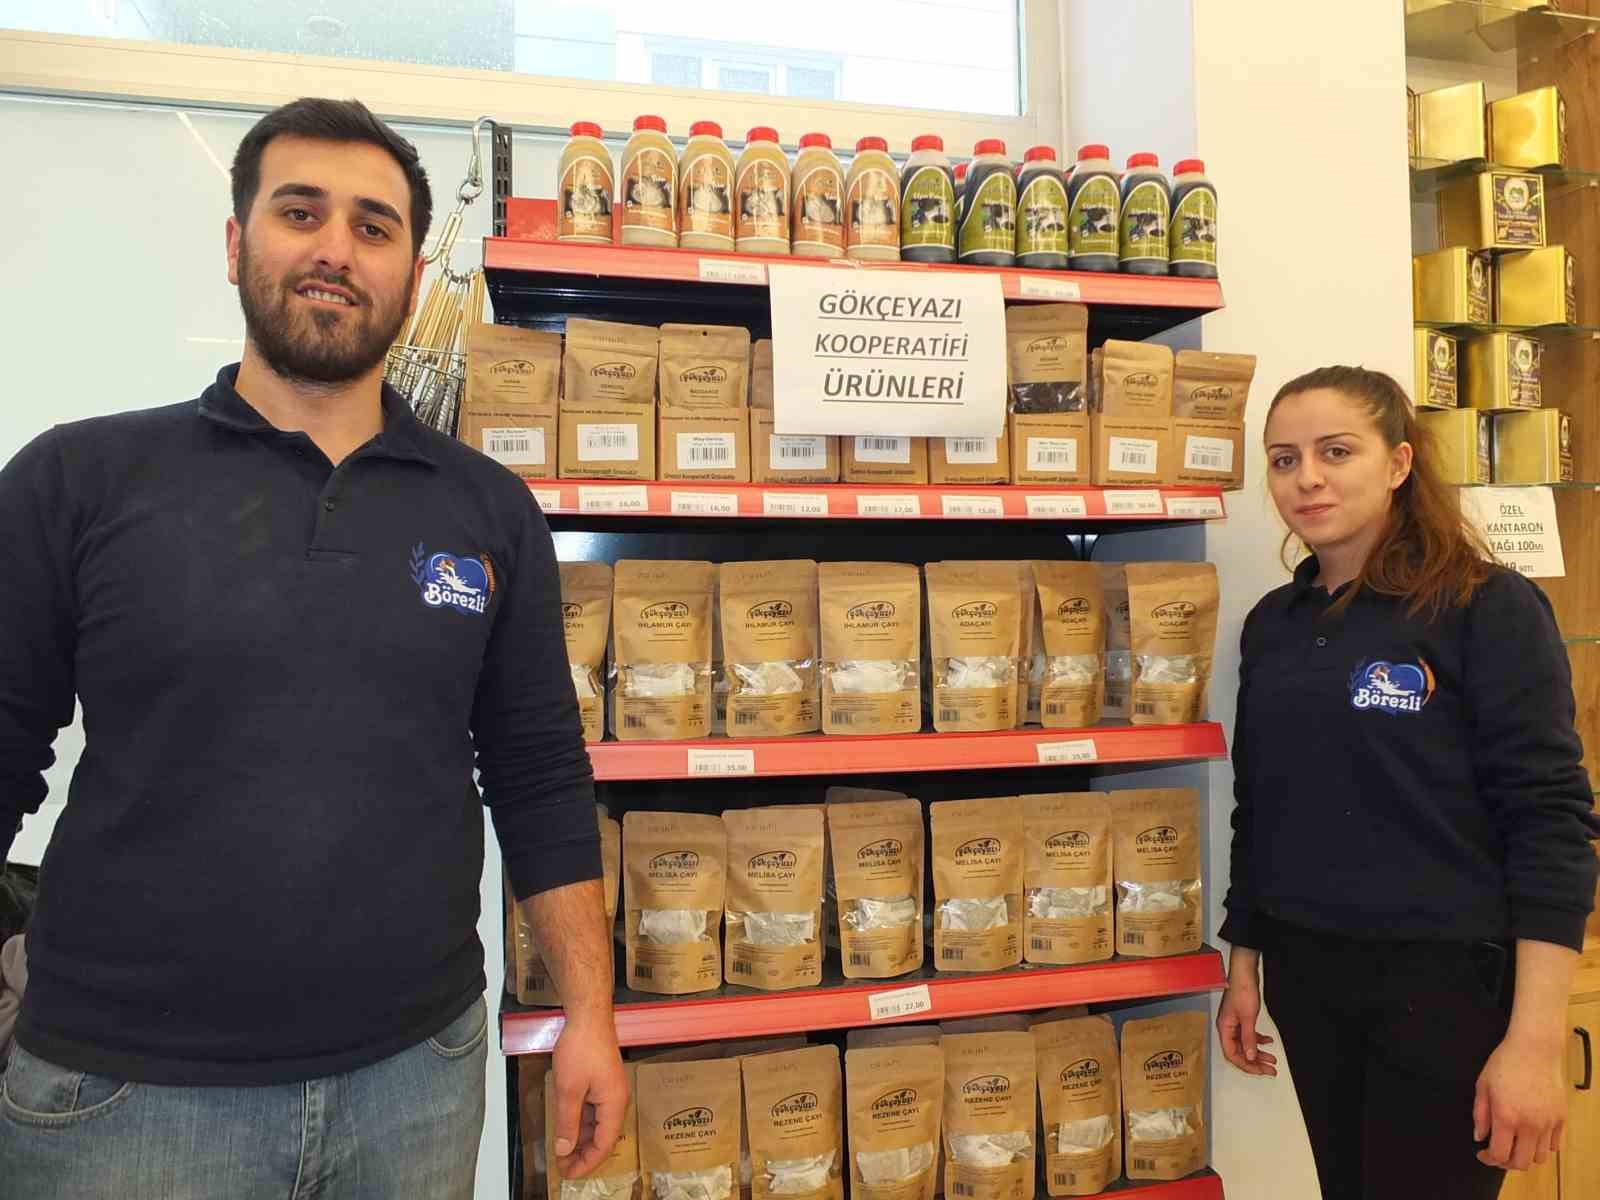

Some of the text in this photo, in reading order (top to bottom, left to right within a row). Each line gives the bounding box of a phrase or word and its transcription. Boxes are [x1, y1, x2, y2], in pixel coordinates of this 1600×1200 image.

[819, 289, 962, 321] GÖKÇEYAZI
[815, 333, 969, 357] KOOPERATİFİ
[824, 367, 965, 400] ÜRÜNLERİ
[1487, 521, 1544, 533] KANTARON
[424, 582, 486, 613] Börezli
[1353, 688, 1422, 712] Börezli
